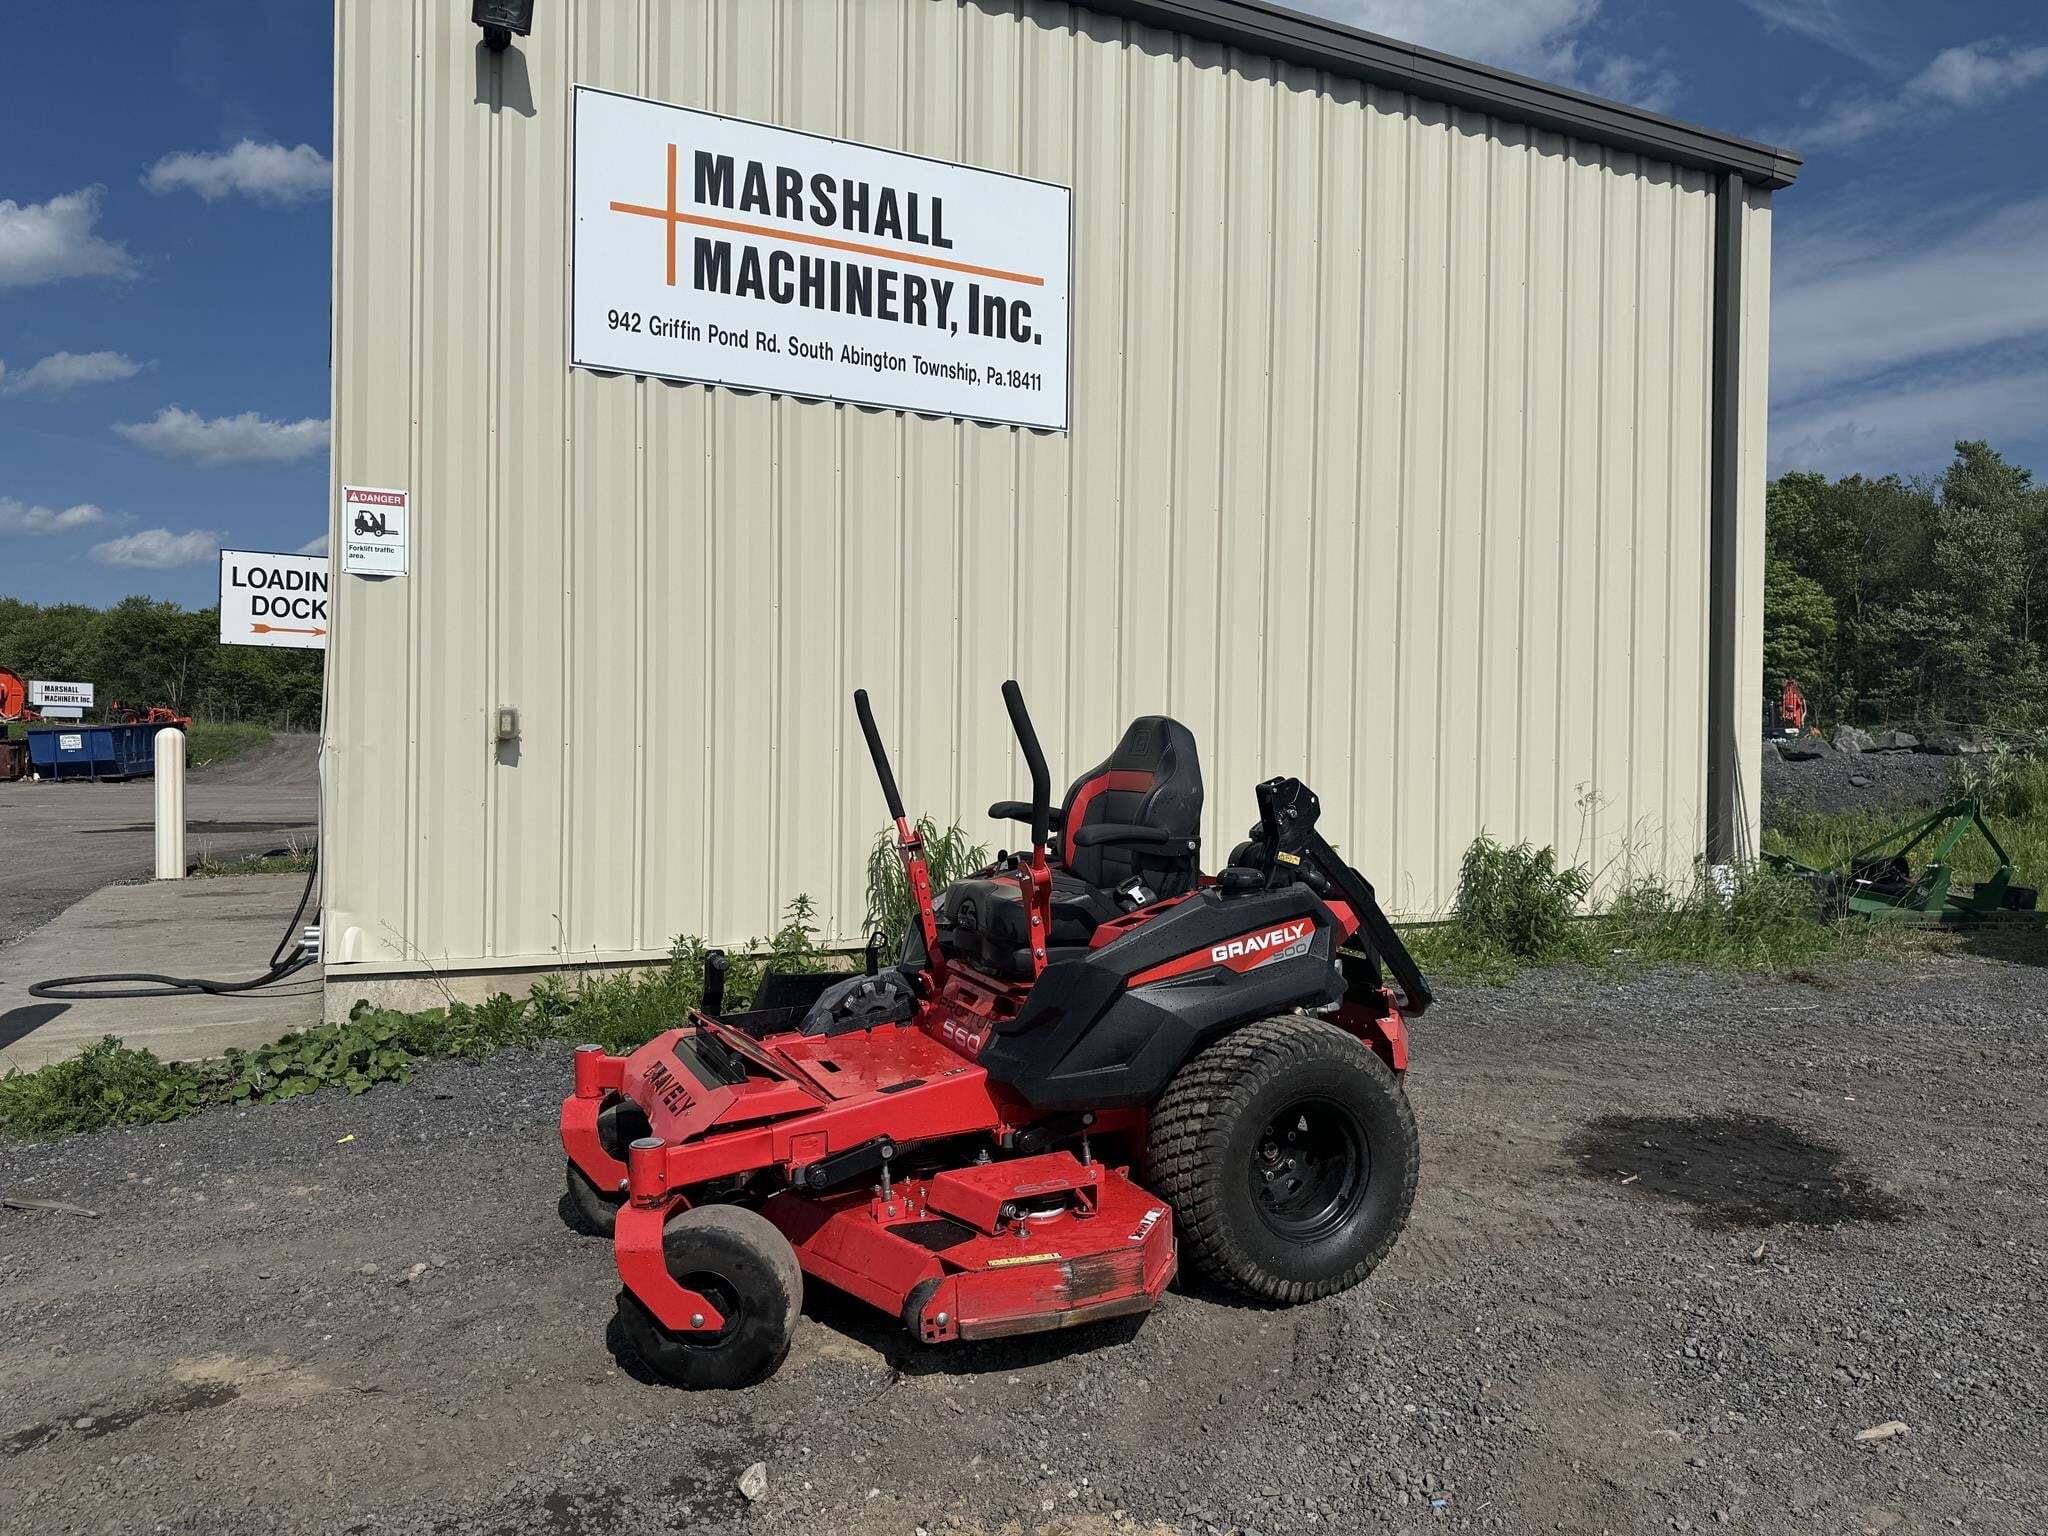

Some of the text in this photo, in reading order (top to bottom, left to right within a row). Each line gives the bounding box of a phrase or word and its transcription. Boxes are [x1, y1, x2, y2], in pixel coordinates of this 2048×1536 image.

[694, 150, 953, 249] MARSHALL
[694, 237, 1042, 345] MACHINERY, Inc.
[607, 309, 1042, 392] 942 Griffin Pond Rd. South Abington Township, Pa.18411
[360, 494, 401, 504] DANGER
[348, 544, 395, 554] Forklift traffic
[251, 595, 327, 620] DOCK
[44, 685, 79, 693] MARSHALL
[1211, 923, 1305, 962] GRAVELY
[1273, 943, 1306, 961] 500
[943, 1019, 981, 1055] 560
